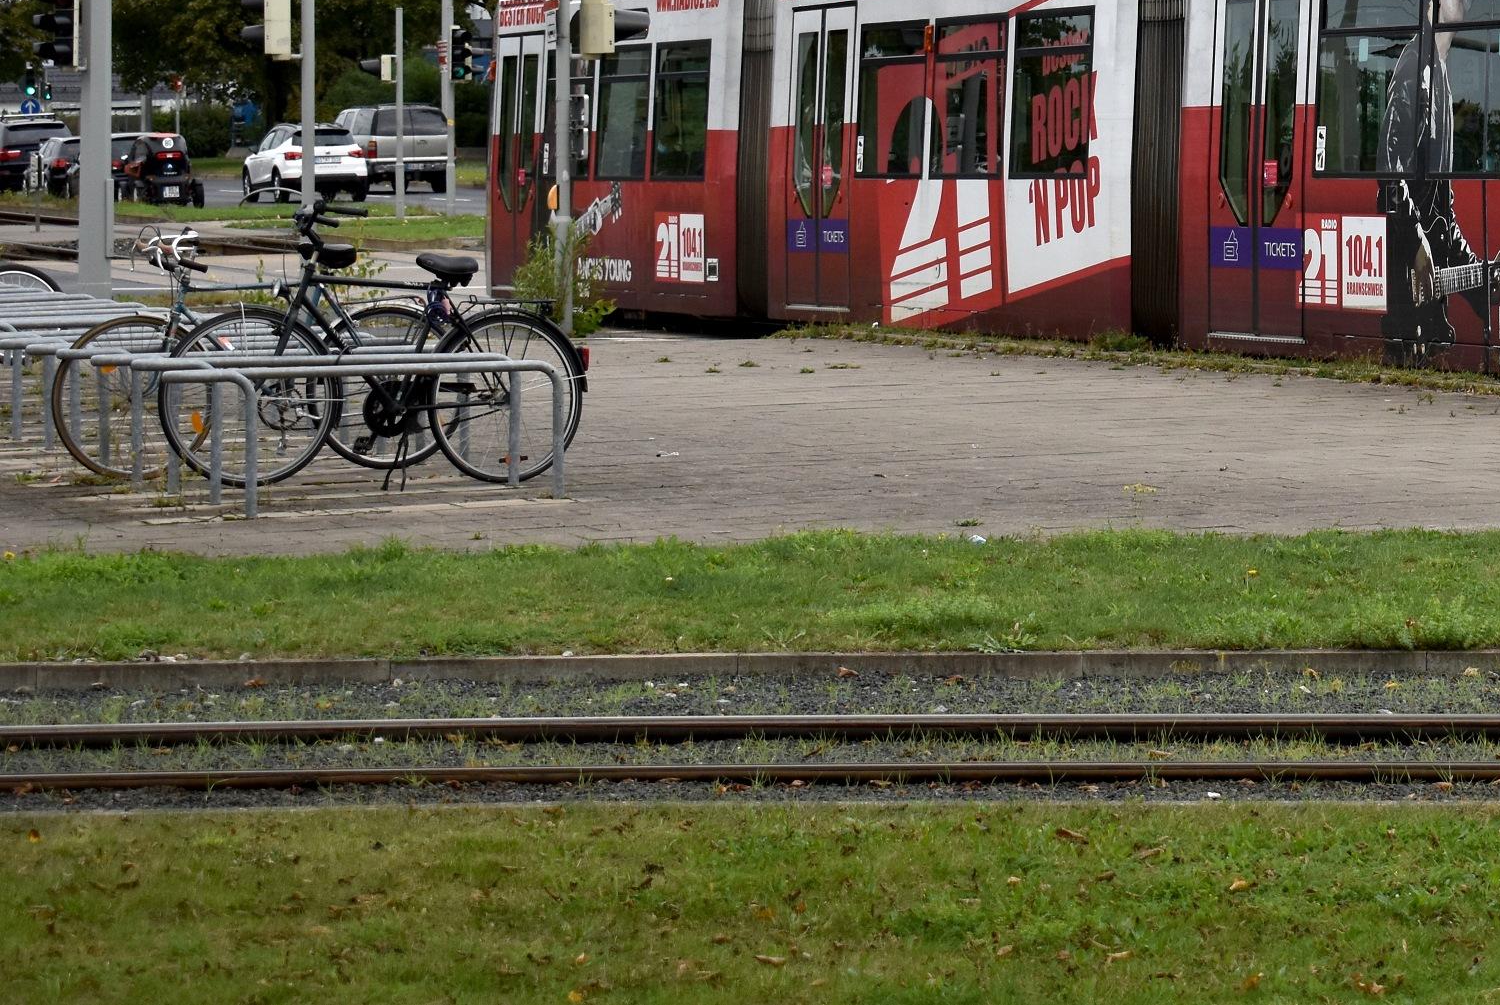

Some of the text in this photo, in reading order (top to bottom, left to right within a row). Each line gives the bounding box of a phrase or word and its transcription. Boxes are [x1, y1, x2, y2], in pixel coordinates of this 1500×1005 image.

[1032, 71, 1098, 164] ROCK
[1054, 156, 1101, 239] POP
[1321, 219, 1337, 229] RADIO
[682, 227, 702, 258] 104.1
[823, 230, 844, 243] TICKETS
[1264, 242, 1296, 257] TICKETS
[1345, 235, 1383, 277] 104.1
[604, 258, 632, 282] YOUNG
[1346, 282, 1384, 297] BRAUNSCHWEIG
